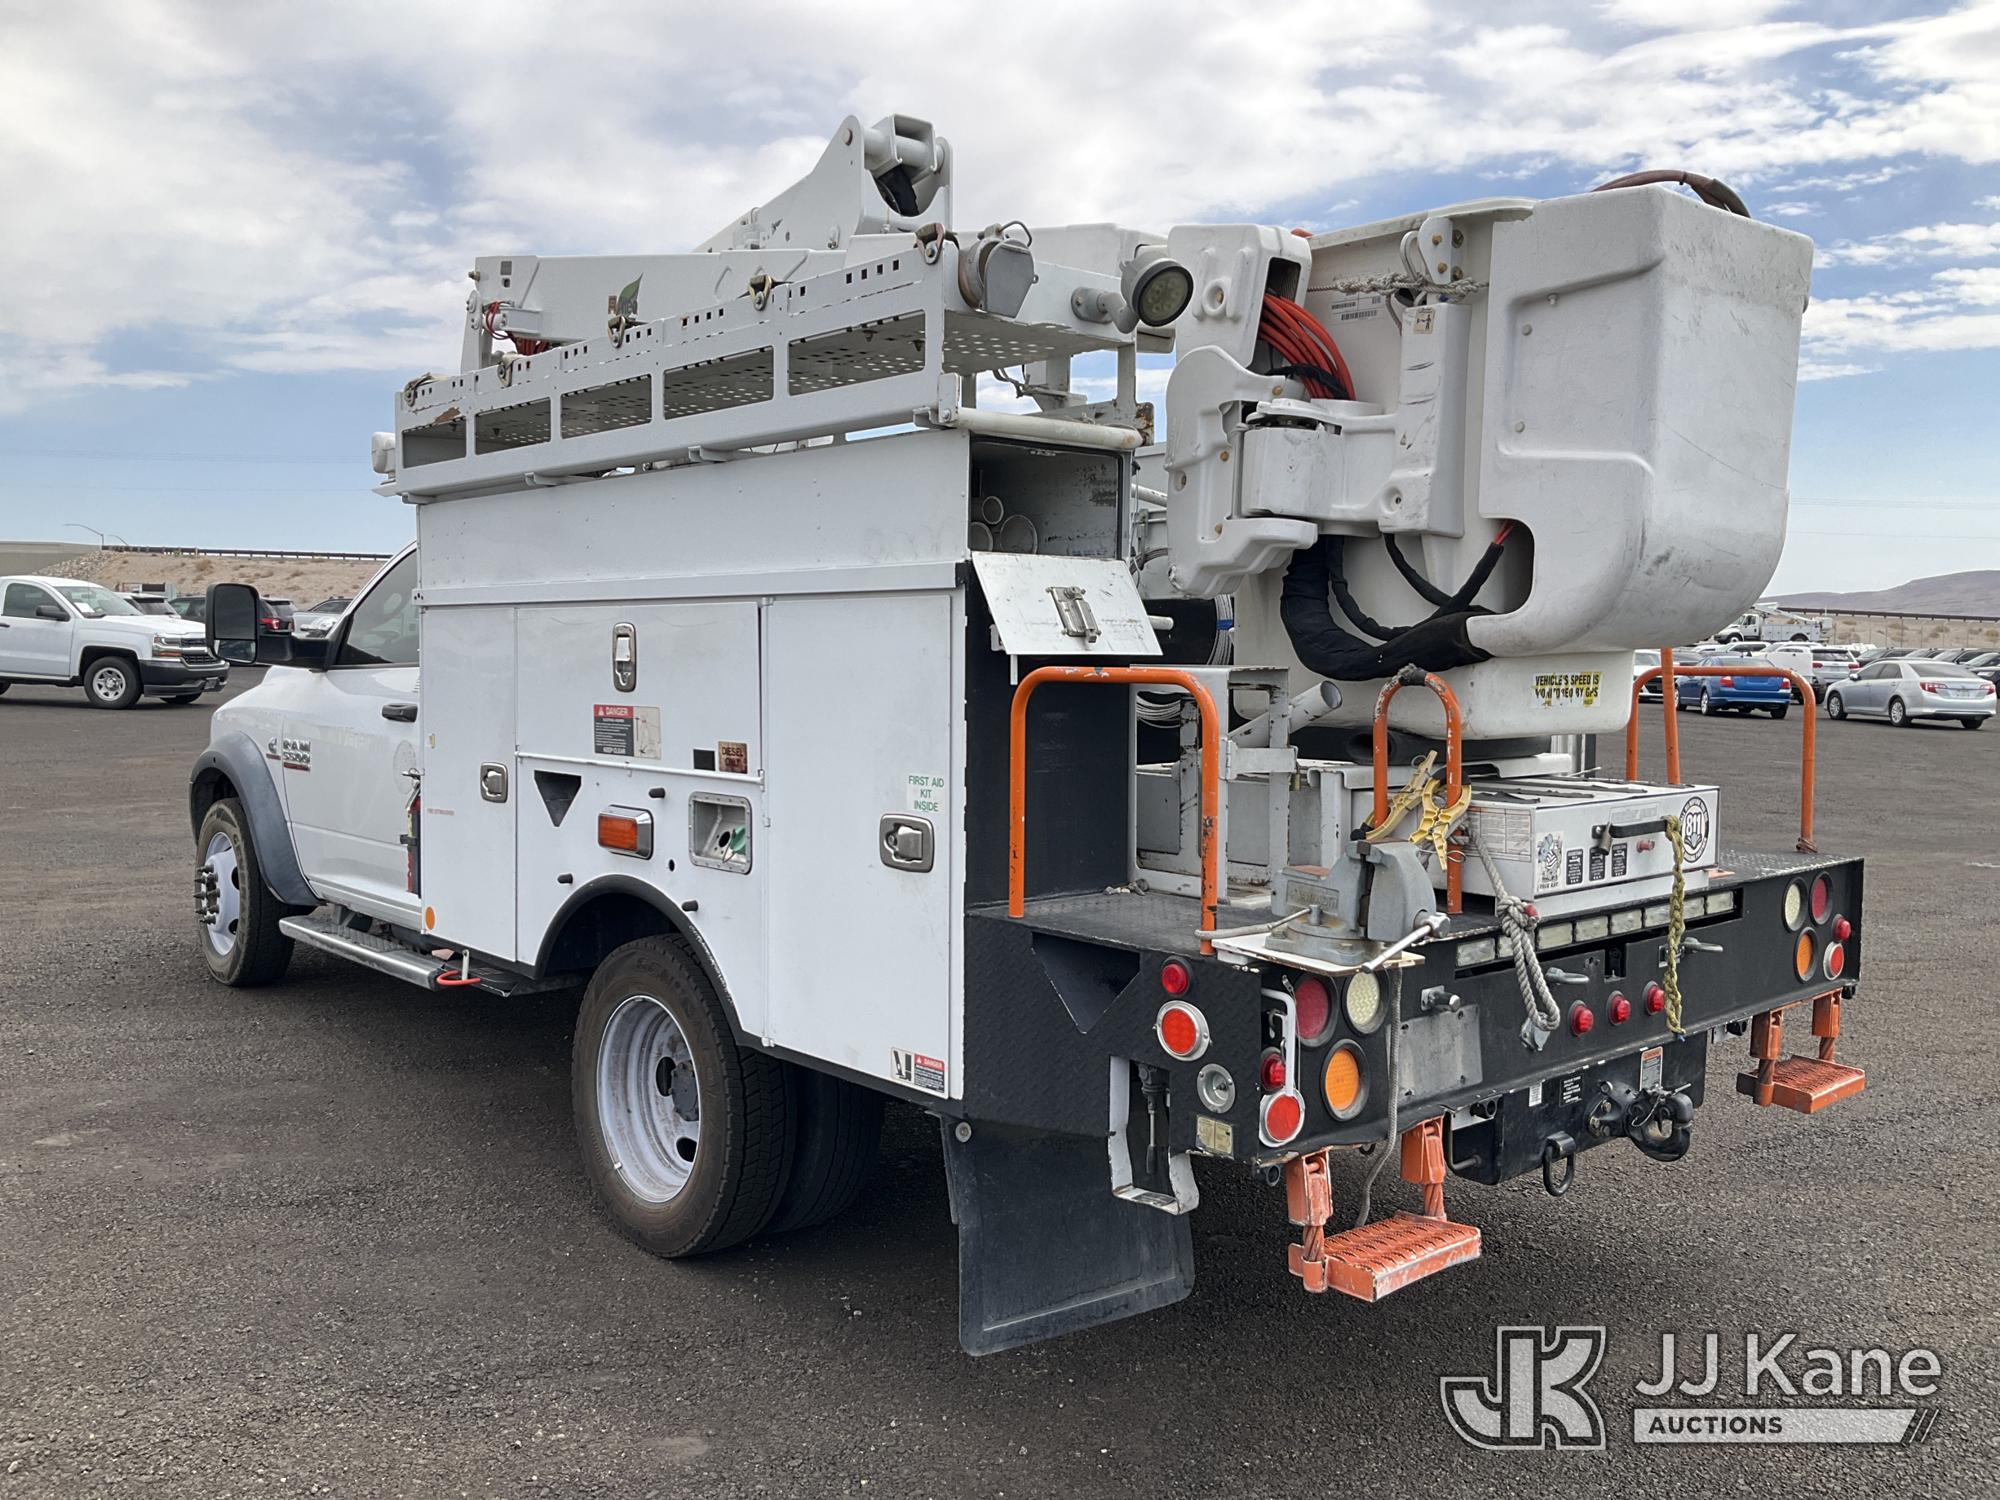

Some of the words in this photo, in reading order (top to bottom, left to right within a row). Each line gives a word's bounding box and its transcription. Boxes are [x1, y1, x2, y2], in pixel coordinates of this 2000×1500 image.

[1535, 674, 1569, 686] VEHICLE'S
[1570, 674, 1592, 686] SPEED
[1592, 674, 1600, 685] IS
[1575, 687, 1584, 698] BY
[605, 706, 629, 716] DANGER
[283, 739, 311, 751] RAM
[282, 751, 311, 763] 5500
[721, 746, 744, 757] DIESEL
[724, 757, 742, 768] ONLY
[908, 775, 929, 786] FIRST
[931, 777, 945, 788] AID
[920, 789, 932, 799] KIT
[913, 800, 939, 812] INSIDE
[1685, 812, 1702, 837] 811
